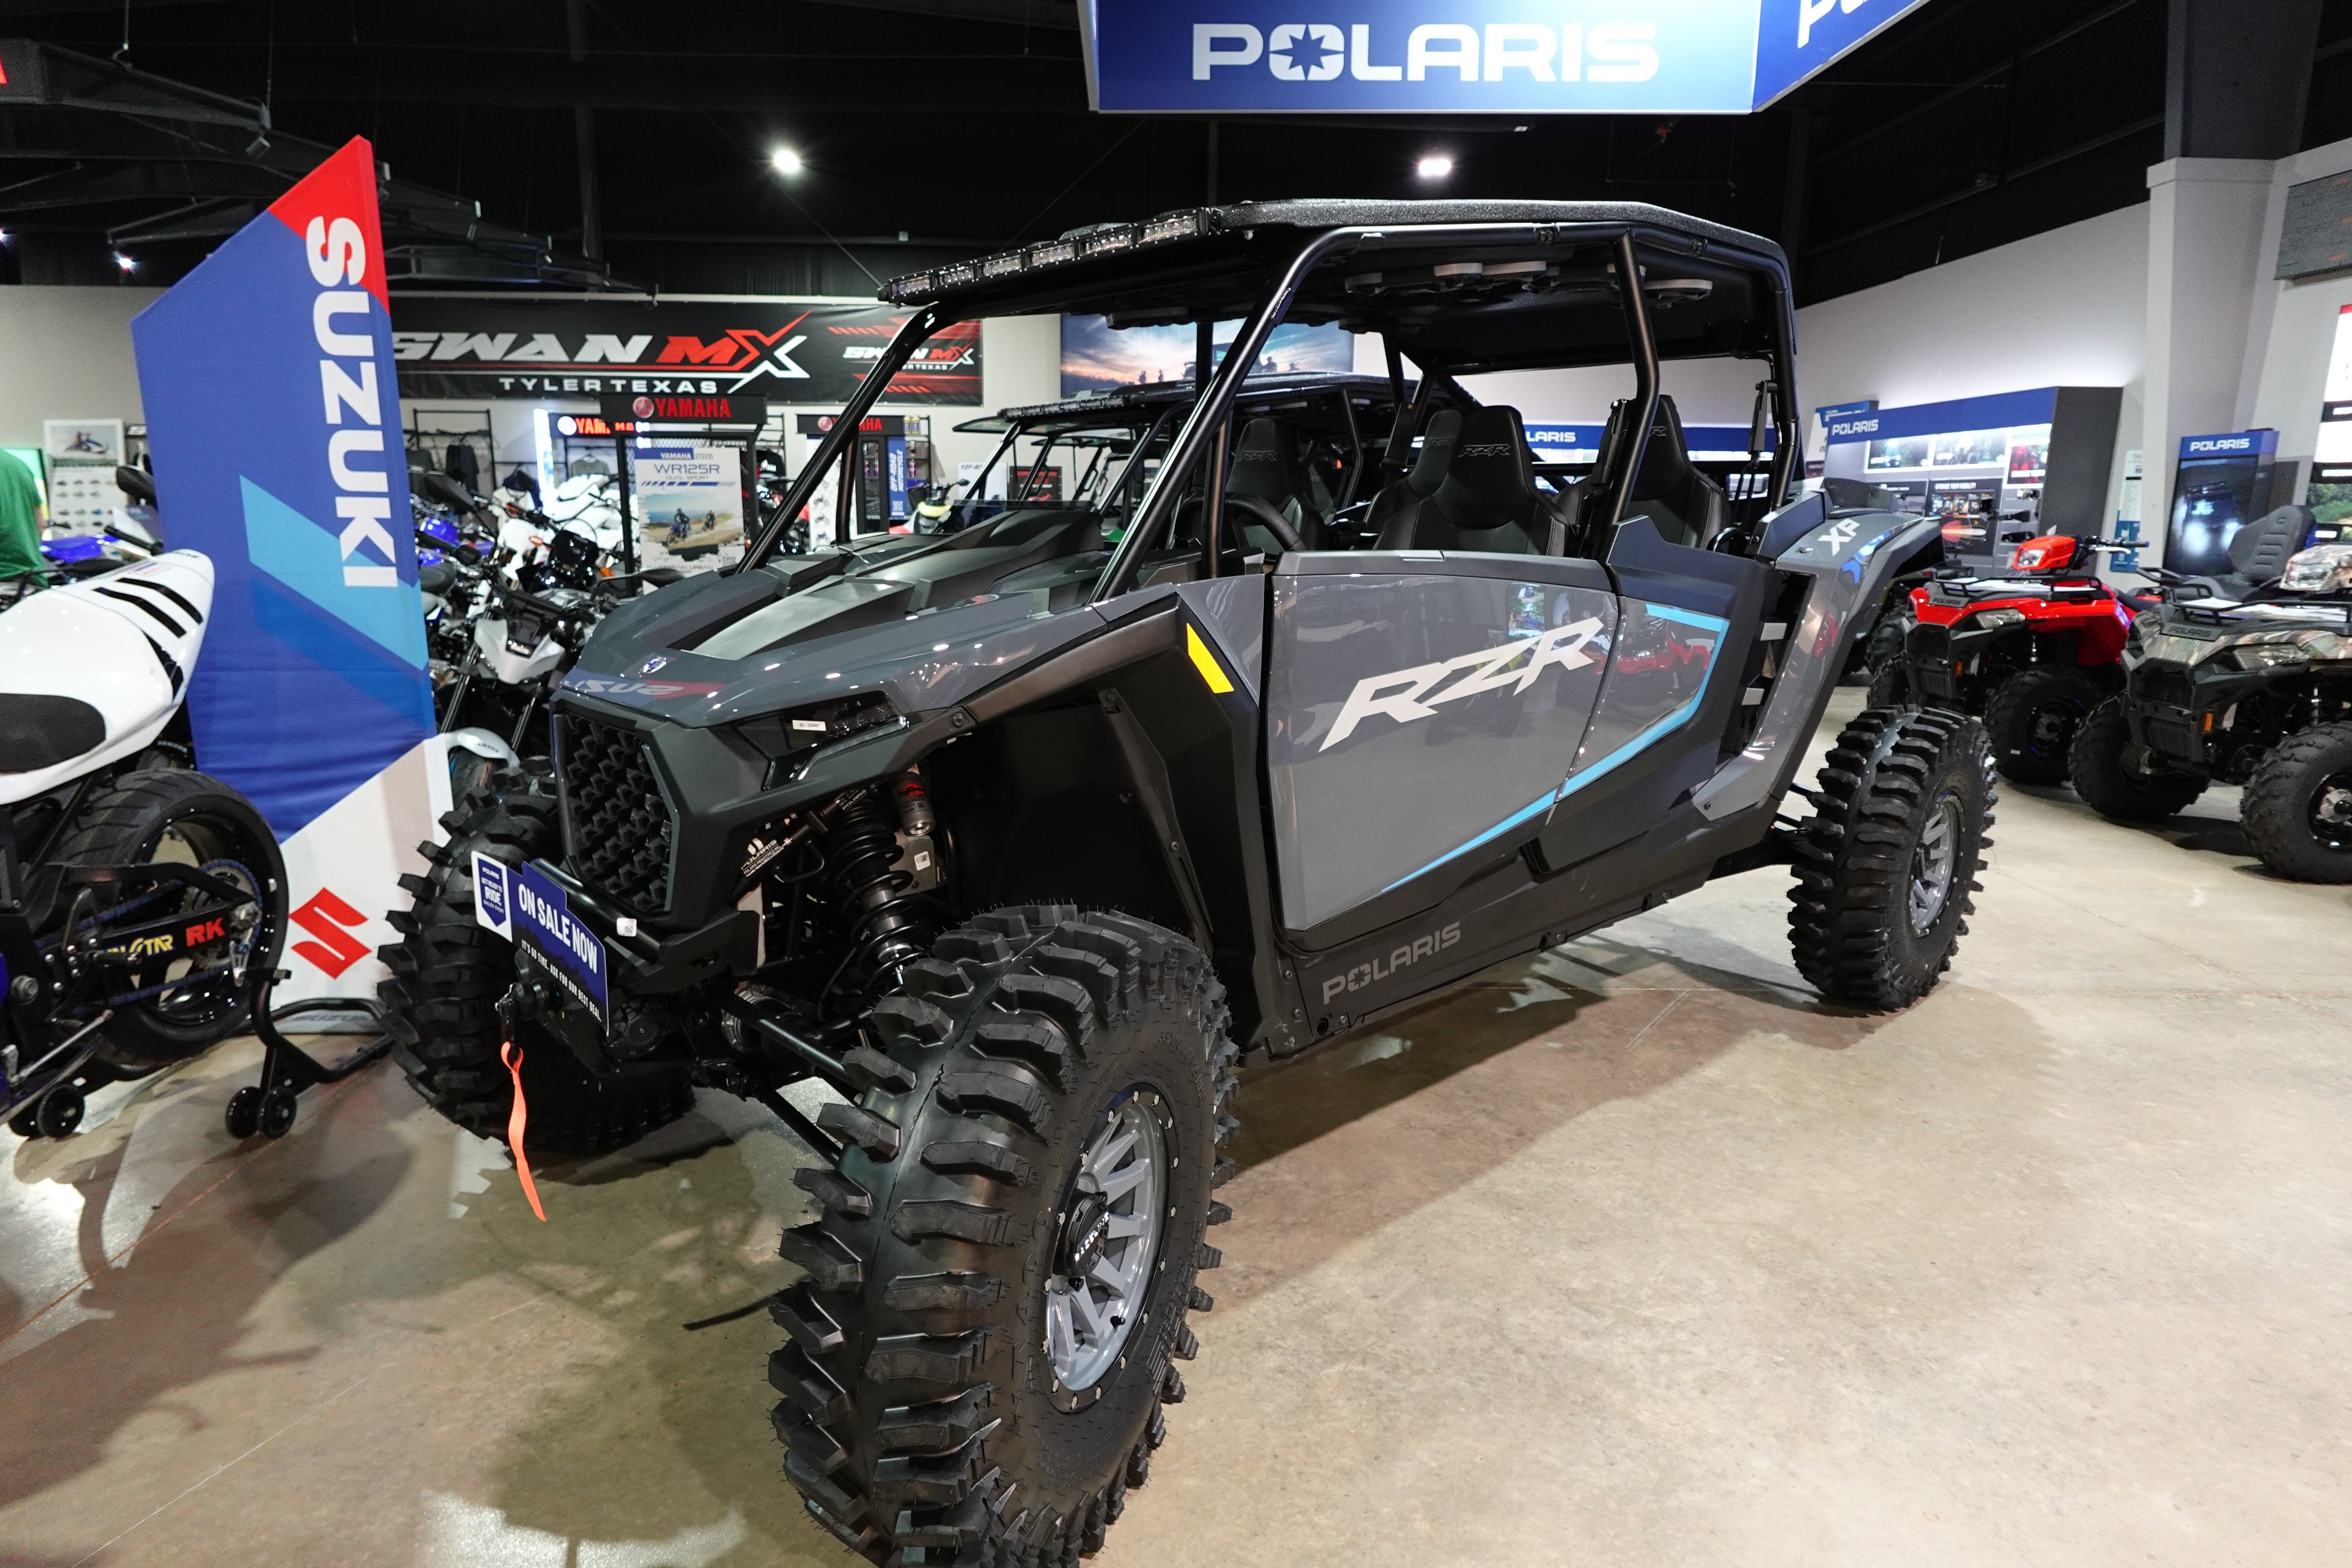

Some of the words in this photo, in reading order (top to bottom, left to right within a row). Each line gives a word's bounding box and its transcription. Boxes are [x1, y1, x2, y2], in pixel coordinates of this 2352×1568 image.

[1192, 23, 1660, 82] POLARIS
[393, 332, 653, 363] SWAN
[843, 346, 929, 359] SWN
[499, 377, 601, 392] TYLER
[611, 379, 717, 393] TEXAS
[306, 215, 398, 587] SUZUKI
[655, 398, 731, 418] YAMAHA
[1525, 431, 1576, 442] LARIS
[1832, 419, 1879, 436] POLARIS
[1459, 444, 1510, 457] RZR
[2190, 438, 2250, 451] POLARIS
[654, 464, 720, 475] WR125R
[888, 453, 898, 492] OFF-ROAD
[1818, 518, 1859, 556] XP
[1319, 617, 1604, 752] RZR
[474, 743, 499, 753] YAMAHA
[842, 789, 867, 810] POLARIS
[484, 886, 502, 906] RIDE
[186, 917, 225, 947] RK
[518, 884, 536, 919] ON
[537, 897, 571, 947] SALE
[572, 923, 597, 974] NOW
[521, 939, 530, 954] IT'S
[531, 947, 537, 960] GO
[537, 952, 549, 971] TIME.
[550, 964, 558, 979] ASK
[559, 971, 567, 987] FOR
[568, 980, 577, 996] OUR
[578, 989, 588, 1008] BEST
[1323, 921, 1461, 1005] POLARIS
